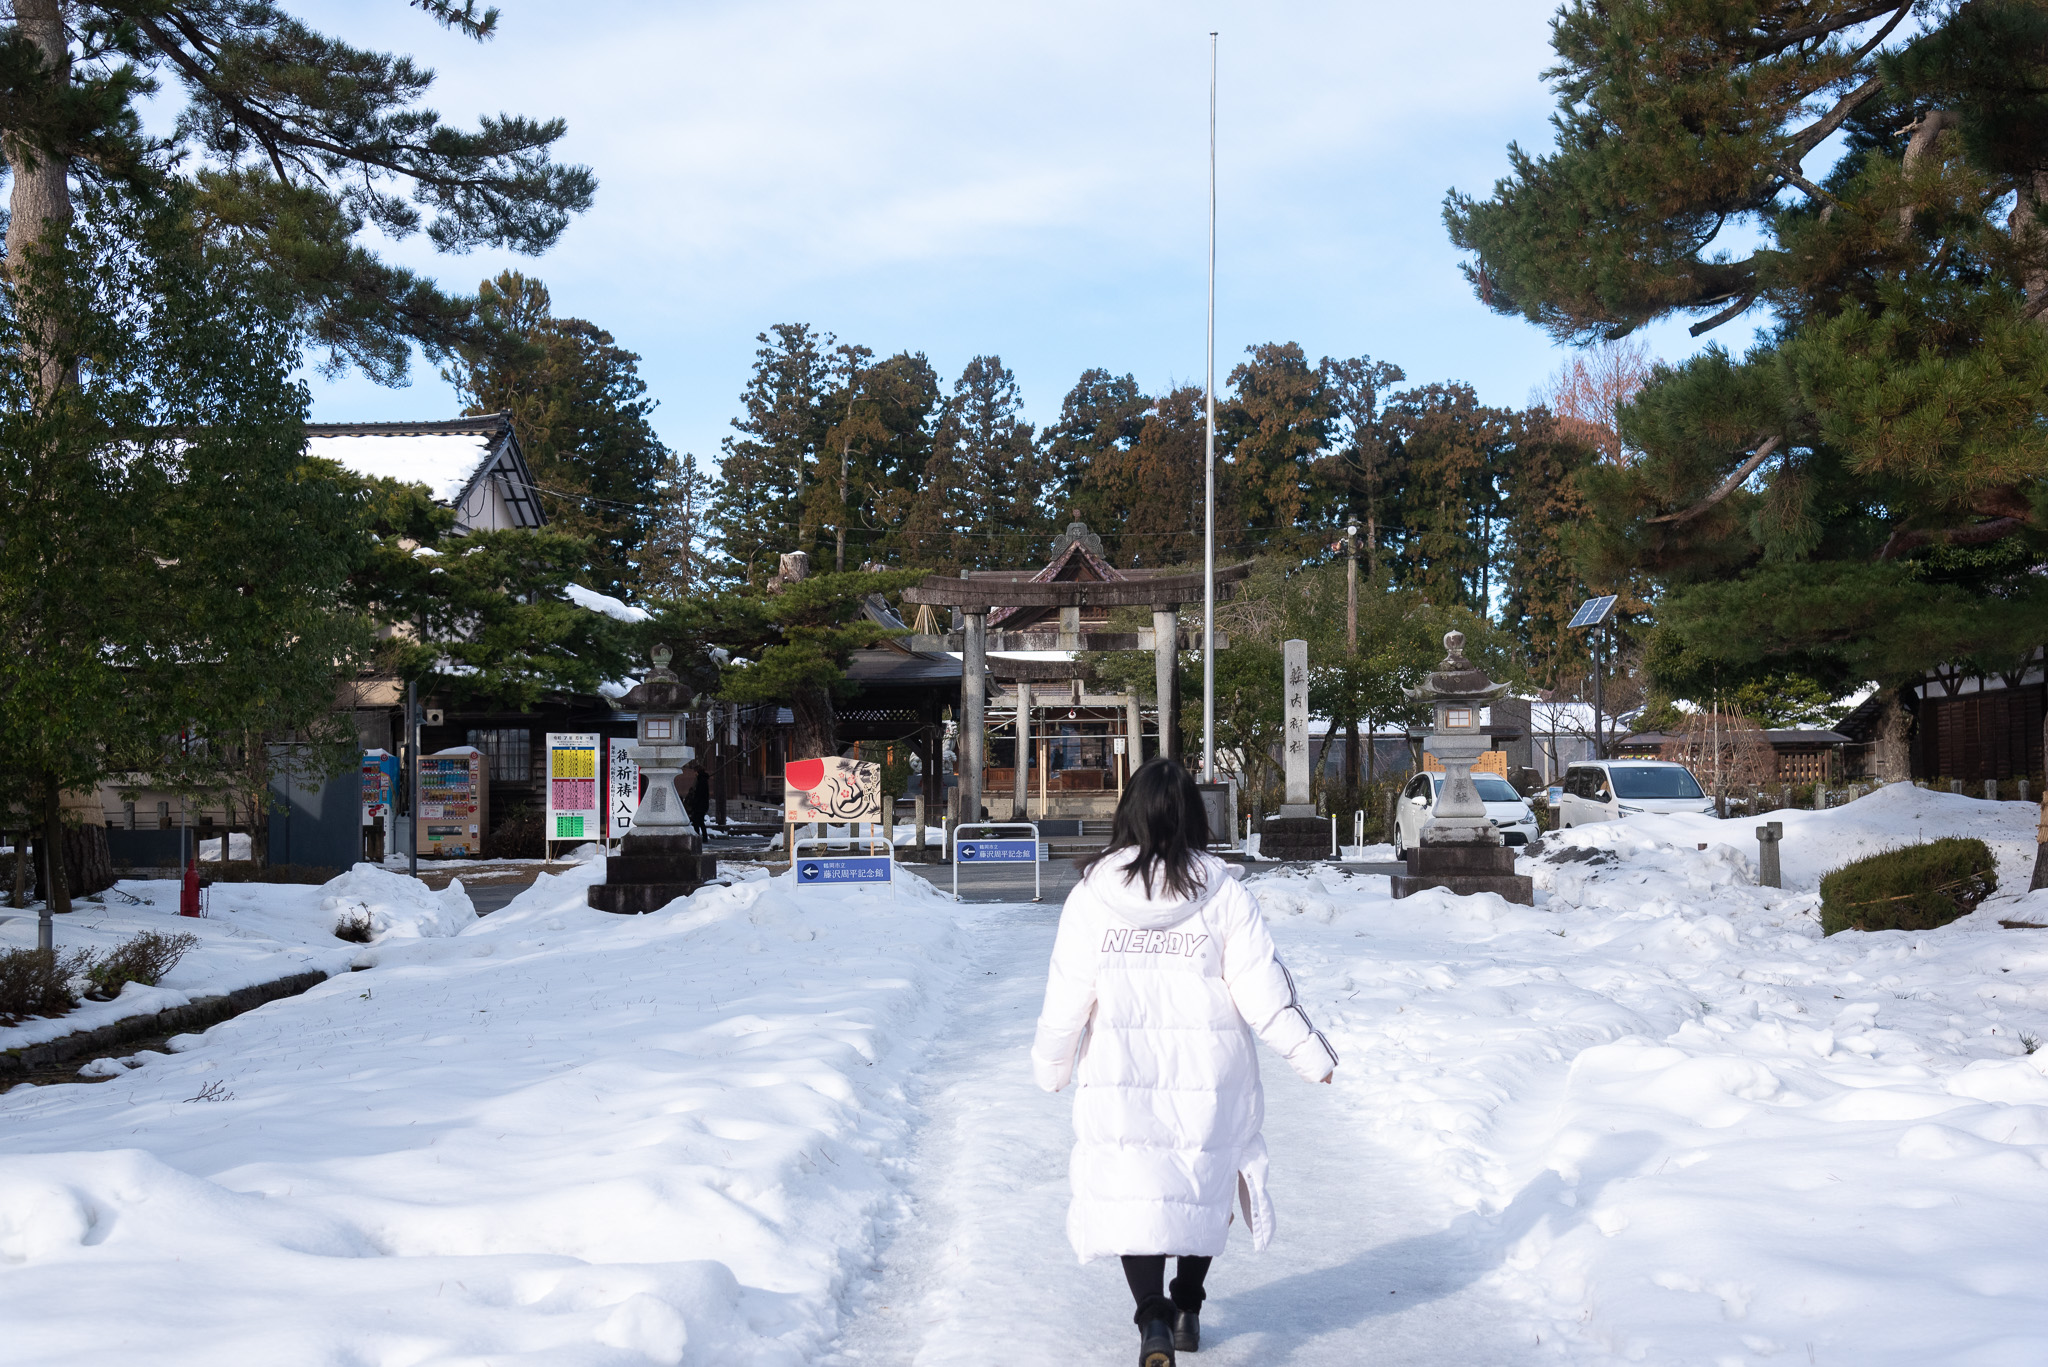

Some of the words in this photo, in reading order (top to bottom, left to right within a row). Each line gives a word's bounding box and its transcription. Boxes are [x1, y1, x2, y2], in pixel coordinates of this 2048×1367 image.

[616, 748, 633, 828] 御祈祷入口
[979, 850, 1031, 858] 藤沢周平記念館
[823, 869, 884, 879] 藤沢周平記念館
[1101, 929, 1208, 957] NERDY
